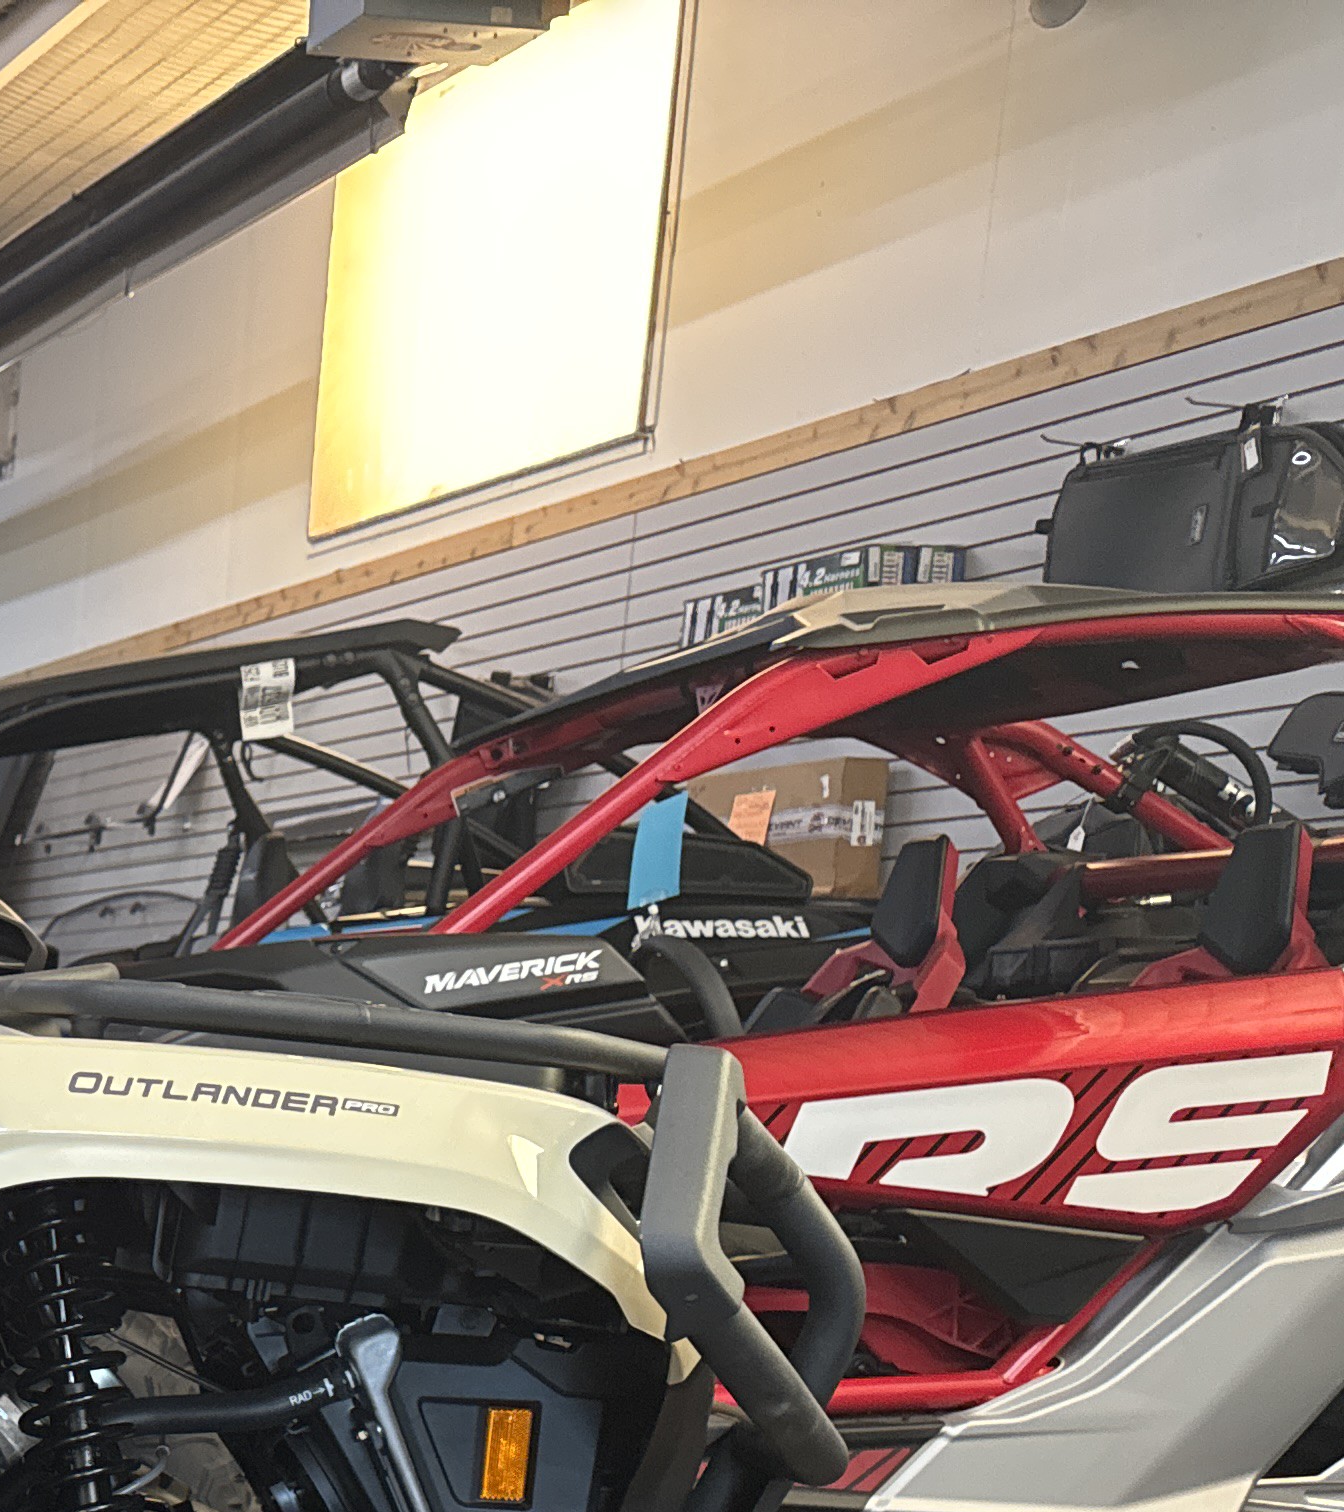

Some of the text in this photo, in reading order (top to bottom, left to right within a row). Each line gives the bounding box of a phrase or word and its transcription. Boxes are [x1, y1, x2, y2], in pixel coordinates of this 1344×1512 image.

[633, 914, 811, 939] Kawasaki
[423, 949, 604, 995] MAVERICK
[67, 1071, 398, 1117] OUTLANDER PRO
[288, 1390, 313, 1407] RAD
